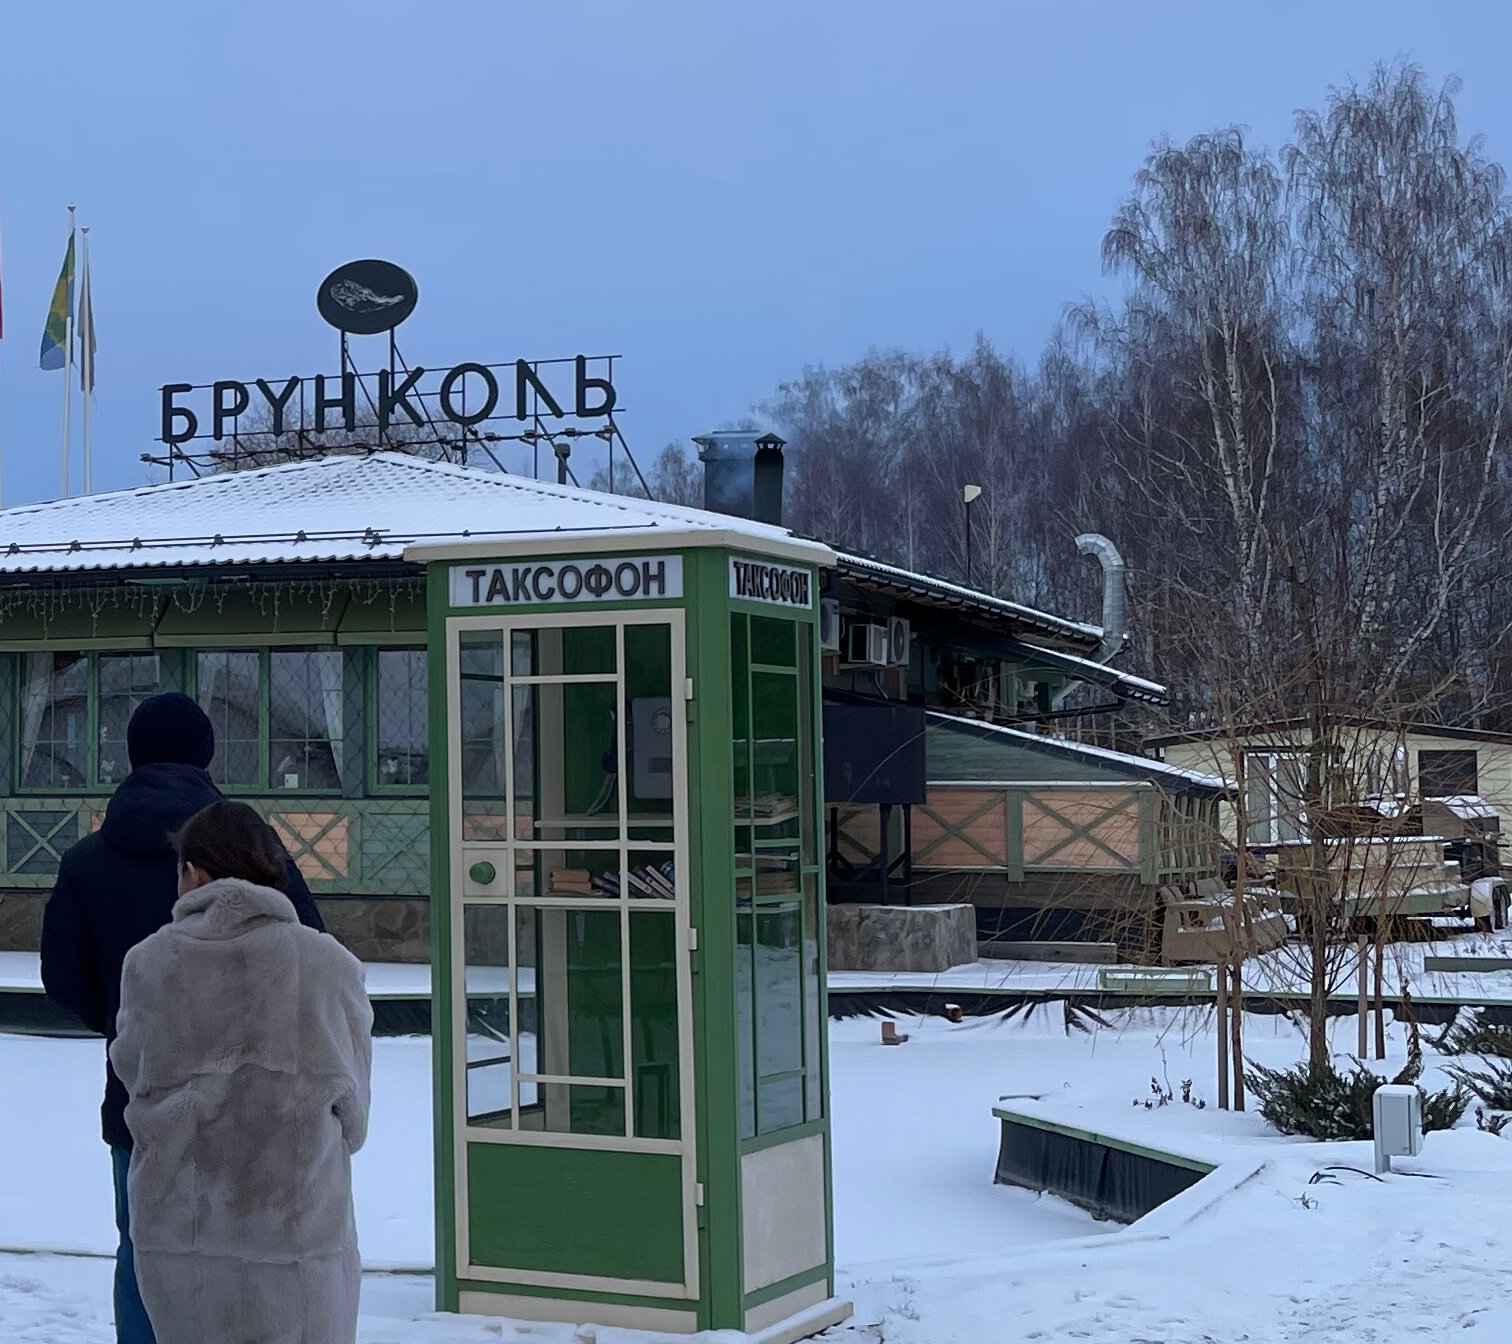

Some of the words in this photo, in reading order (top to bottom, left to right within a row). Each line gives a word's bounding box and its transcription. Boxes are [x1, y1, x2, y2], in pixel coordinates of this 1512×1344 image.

[161, 354, 617, 443] БРУНКОЛЬ
[465, 560, 666, 603] ТАКСОФОН
[733, 560, 810, 605] ТАКСОФОН
